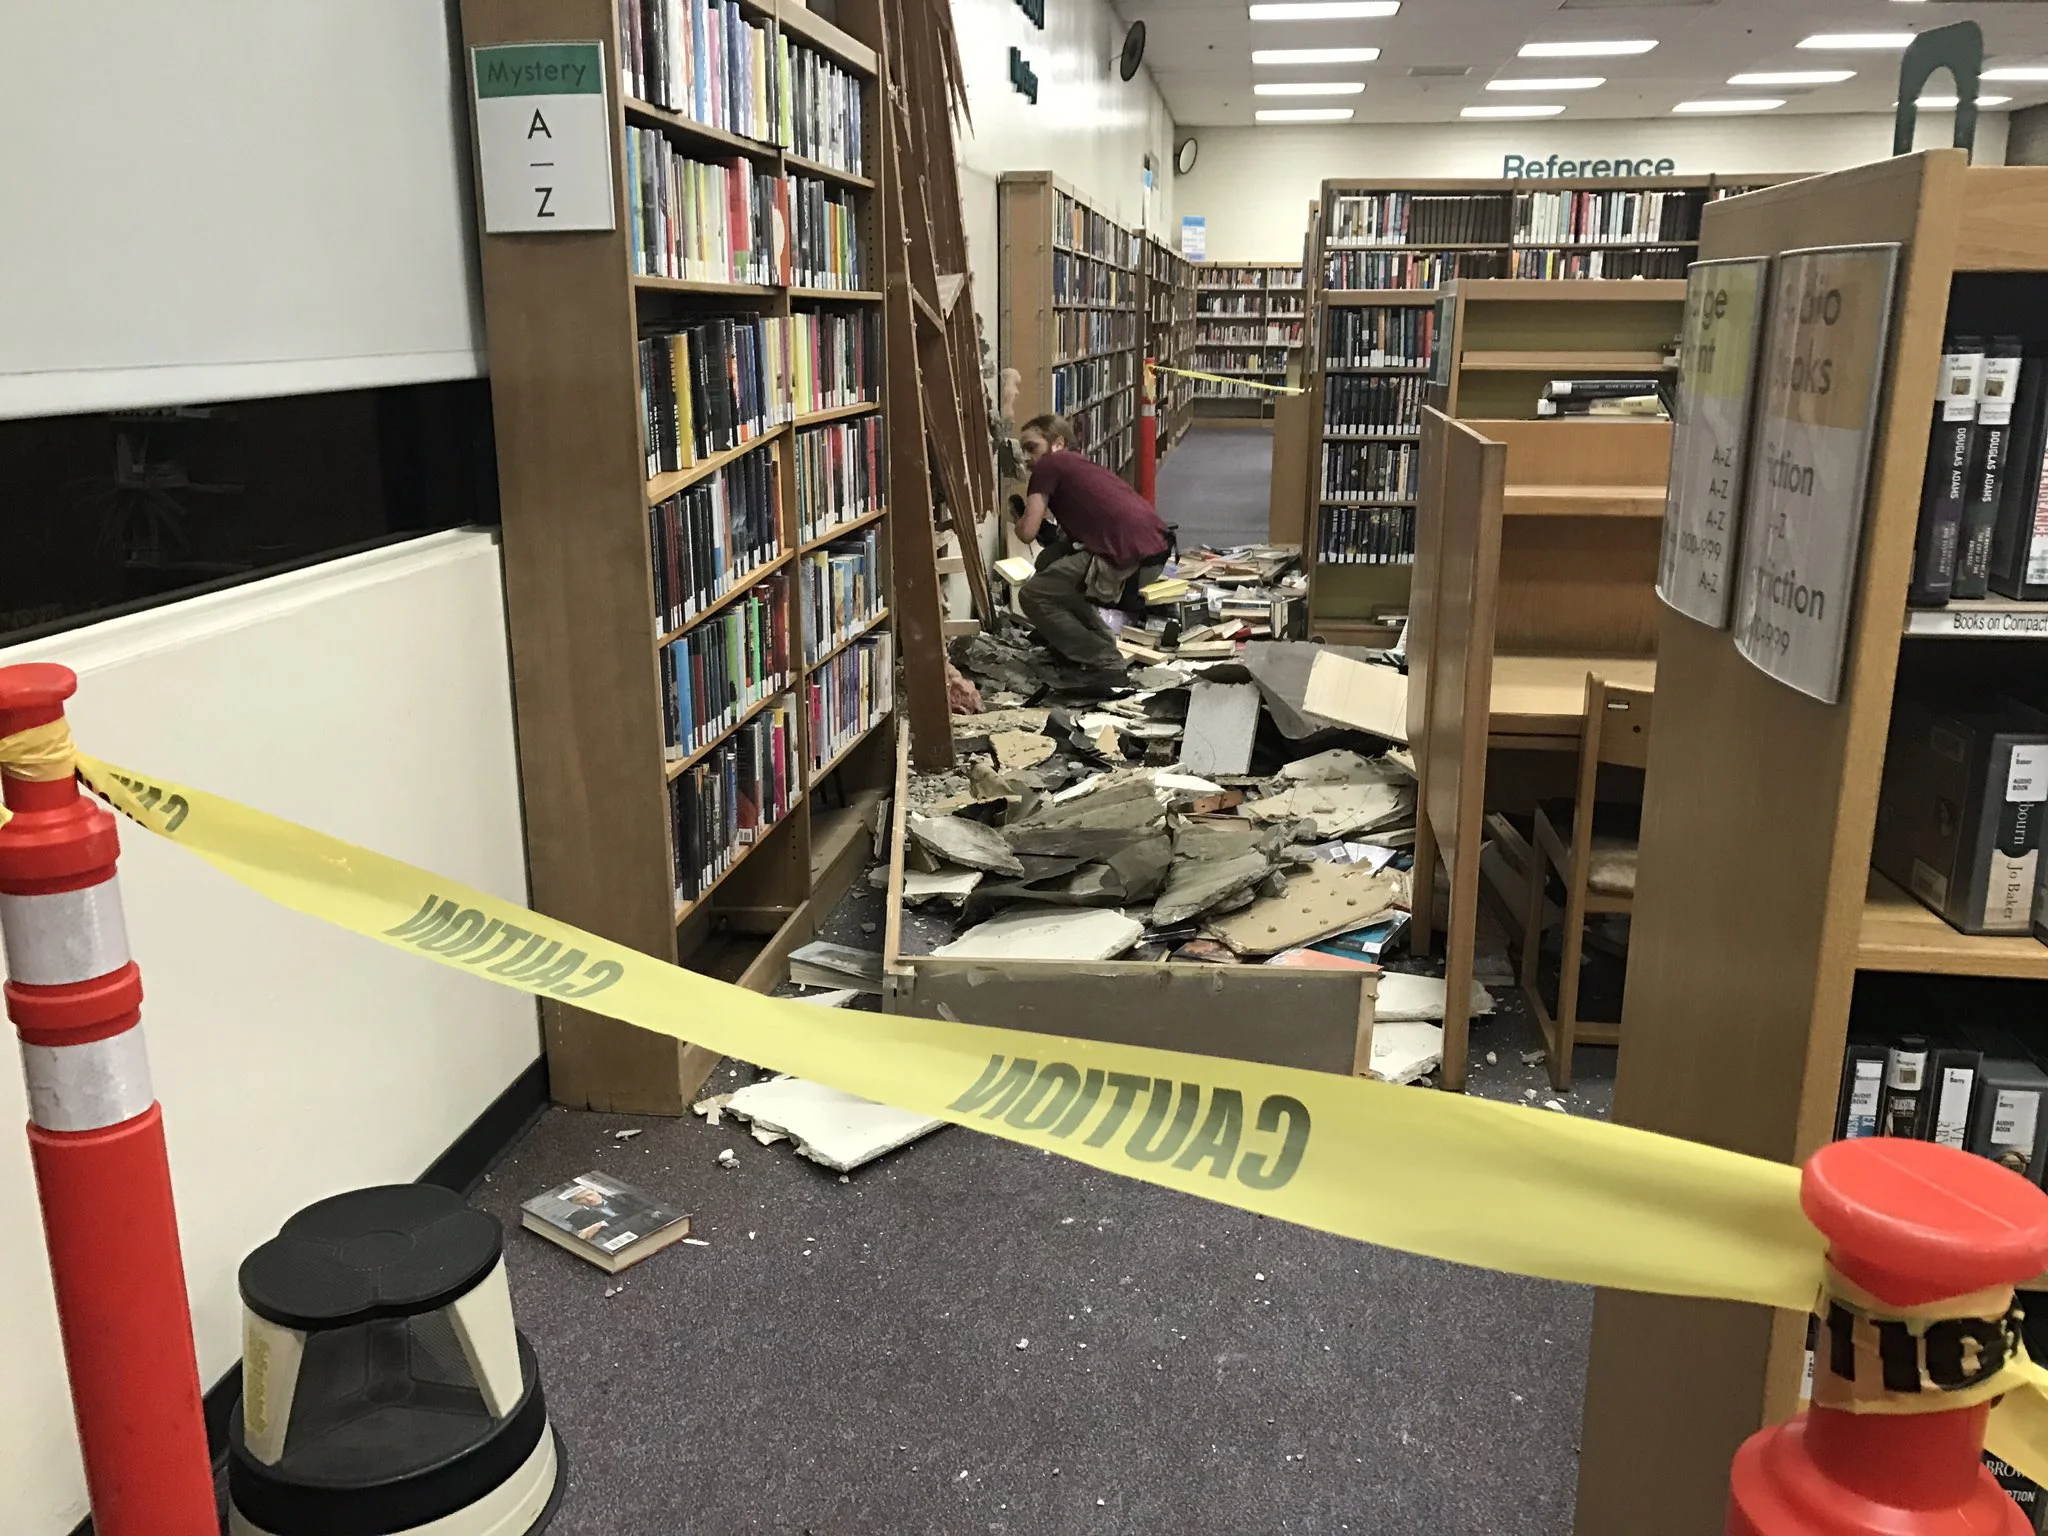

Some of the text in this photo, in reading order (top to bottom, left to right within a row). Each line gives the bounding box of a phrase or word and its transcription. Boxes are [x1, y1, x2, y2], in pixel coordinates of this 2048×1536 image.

[487, 60, 586, 88] Mystery
[527, 108, 552, 139] A
[1502, 154, 1675, 179] Reference
[535, 187, 555, 217] Z
[1712, 445, 1732, 468] A-Z
[1953, 428, 1967, 467] DOUGLAS
[1987, 431, 2000, 470] DOUGLAS
[1709, 477, 1729, 500] A-Z
[1950, 470, 1961, 499] ADAMS
[1982, 473, 1994, 502] ADAMS
[1705, 510, 1726, 531] A-Z
[1699, 571, 1718, 594] A-Z
[1953, 613, 2048, 632] Books on Compact
[2014, 801, 2035, 845] bourn
[2004, 863, 2023, 919] Jo Baker
